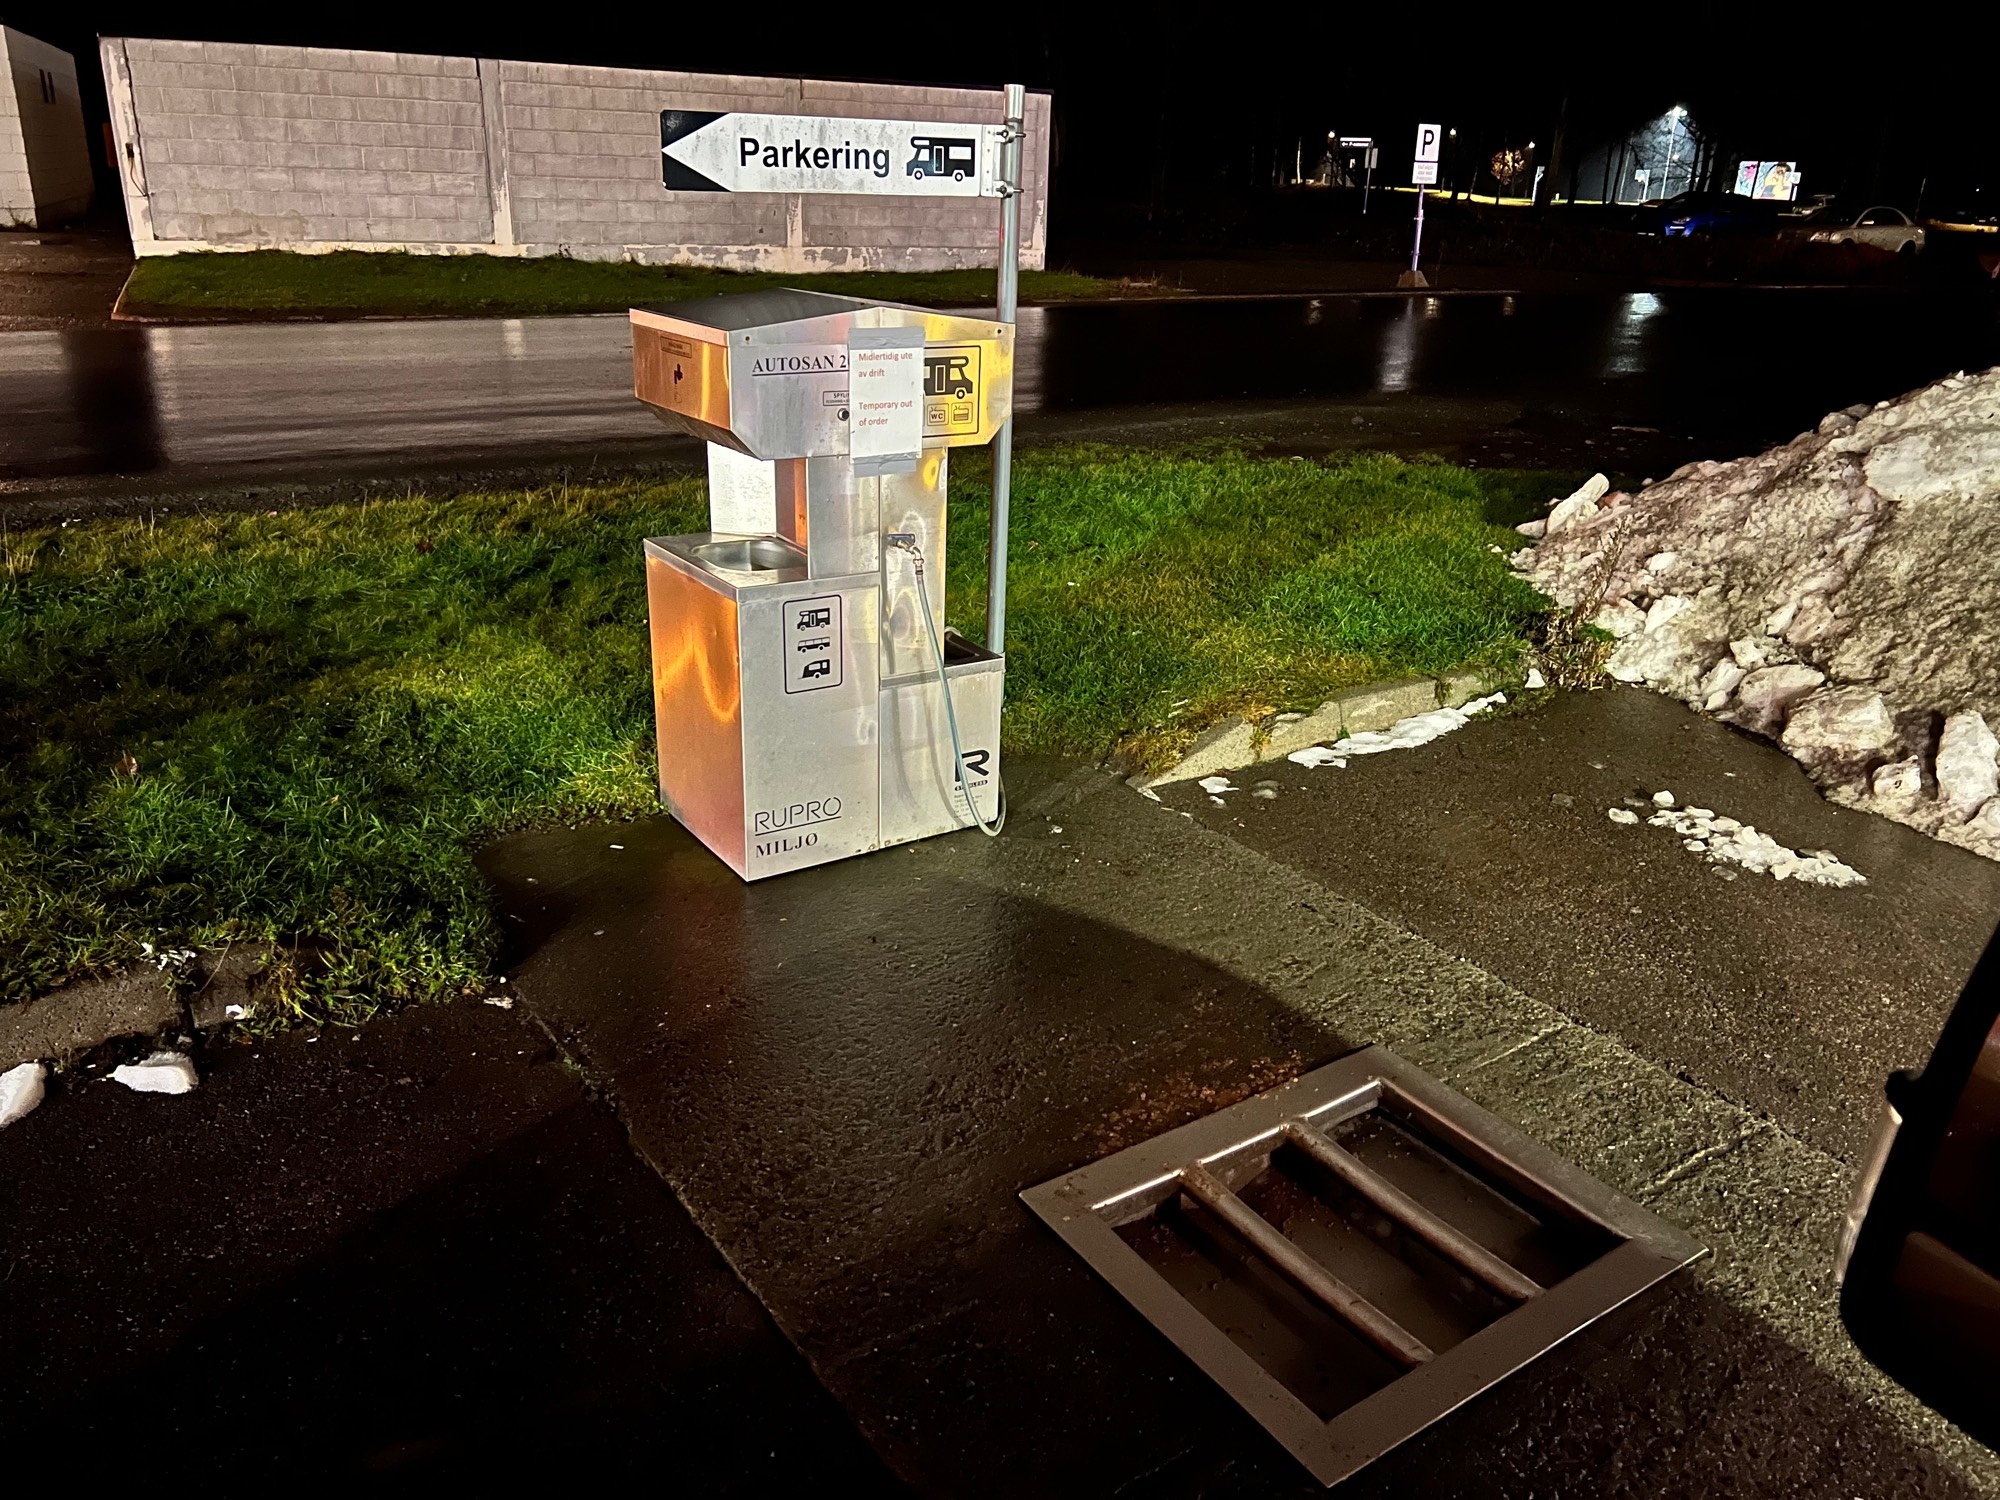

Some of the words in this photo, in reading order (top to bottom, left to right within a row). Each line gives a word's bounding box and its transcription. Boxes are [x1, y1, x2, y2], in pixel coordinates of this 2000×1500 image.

[1421, 129, 1434, 156] P
[739, 137, 890, 178] Parkering
[752, 355, 835, 373] AUTOSAN
[858, 352, 899, 362] Midlertidig
[900, 352, 913, 360] ute
[868, 368, 885, 377] drift
[858, 402, 898, 411] Temporary
[900, 400, 913, 408] out
[858, 418, 866, 427] of
[868, 417, 888, 426] order
[754, 796, 842, 833] RUPRO
